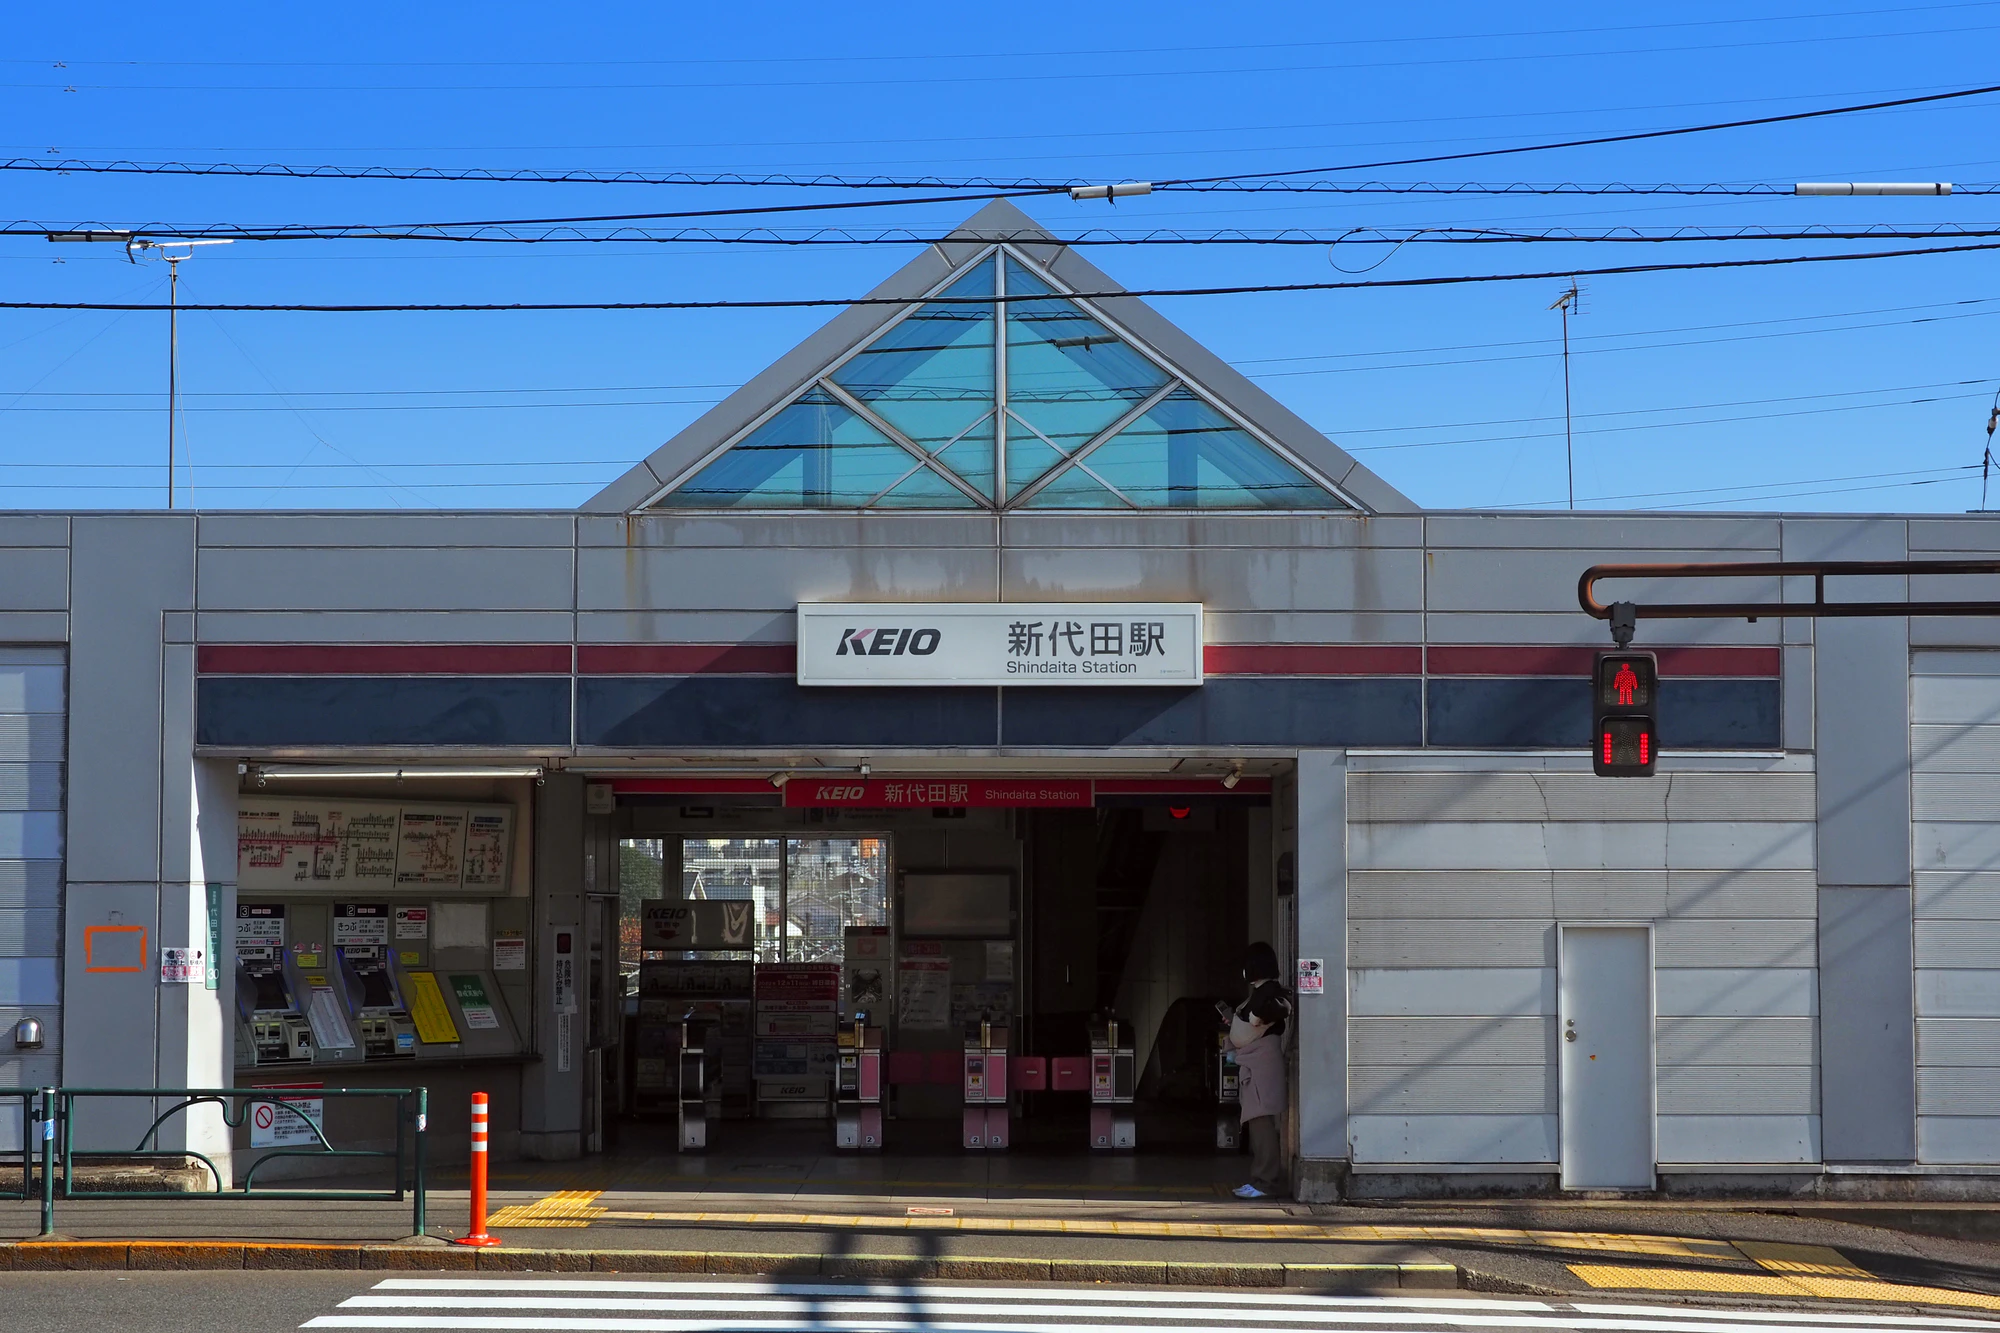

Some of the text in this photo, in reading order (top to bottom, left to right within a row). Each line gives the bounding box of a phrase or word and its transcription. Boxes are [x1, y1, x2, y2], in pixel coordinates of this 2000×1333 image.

[836, 628, 941, 656] KEIO
[1007, 621, 1166, 657] 新代田駅
[1007, 660, 1137, 674] Shindaita Station
[816, 783, 1080, 803] KEIO 新代田駅 Shindaita Station
[242, 907, 248, 915] 3
[348, 907, 354, 915] 2
[647, 908, 688, 919] KEIO
[210, 907, 218, 963] 代田五丁目
[207, 968, 219, 980] 30
